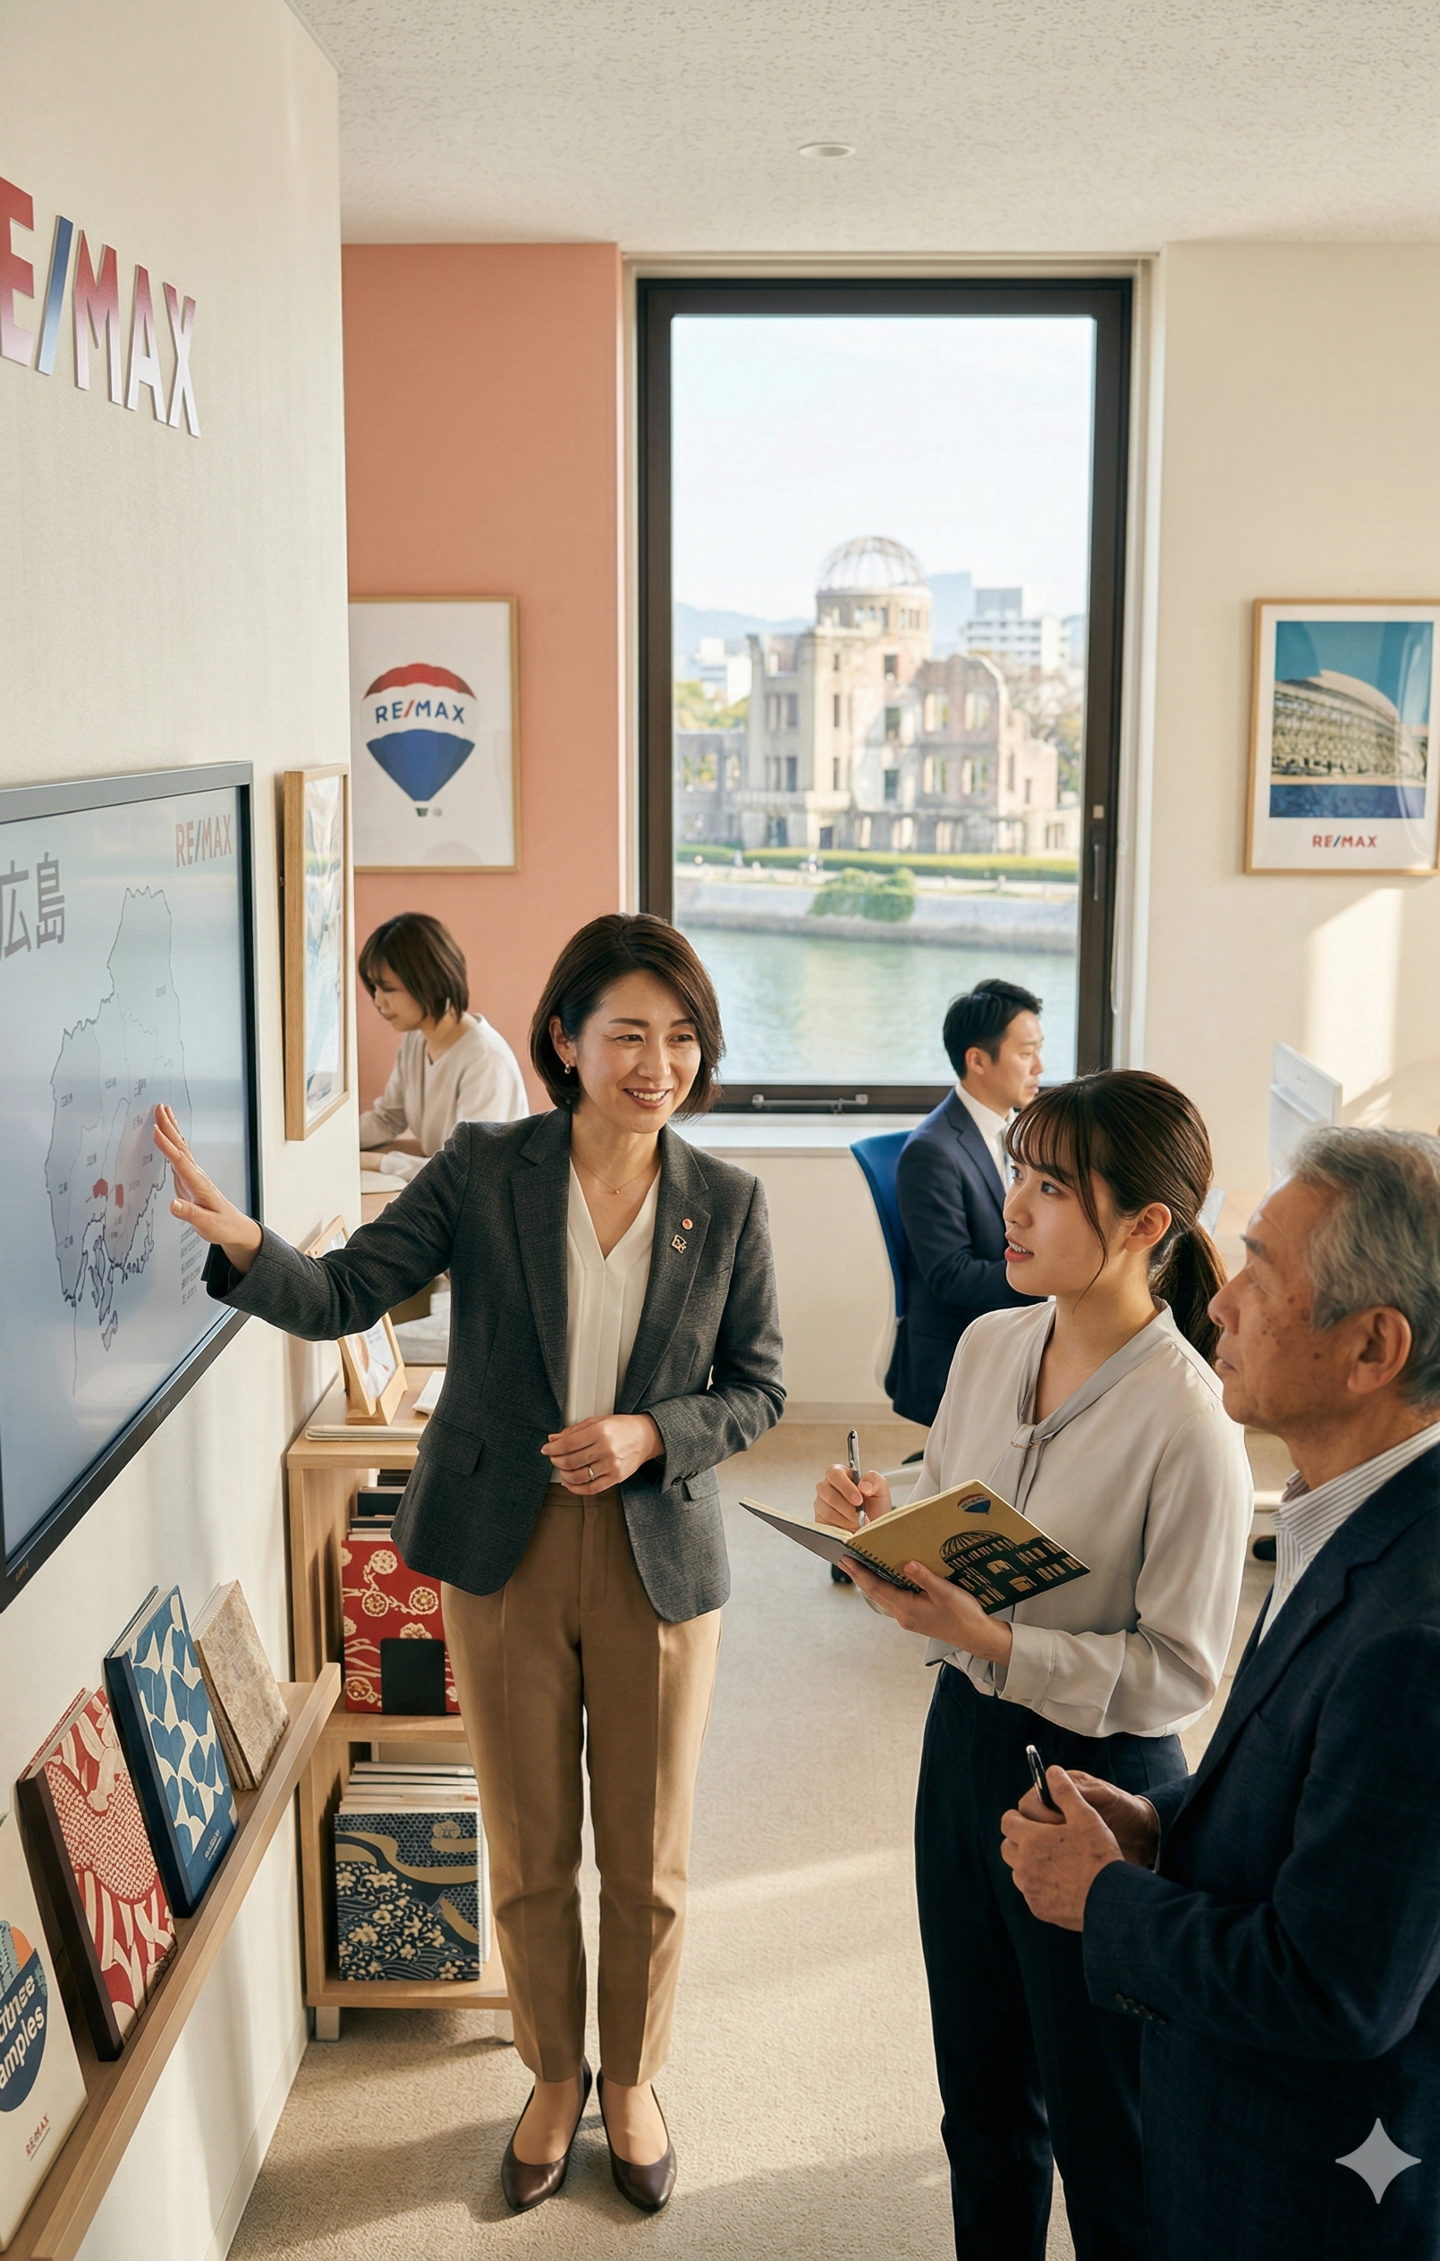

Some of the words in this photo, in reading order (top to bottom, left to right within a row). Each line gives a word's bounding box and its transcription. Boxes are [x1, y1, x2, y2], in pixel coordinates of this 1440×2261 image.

[375, 699, 465, 724] RE/MAX
[175, 813, 232, 868] RE/MAX
[1312, 834, 1377, 848] RE/MAX
[0, 851, 65, 959] 広島
